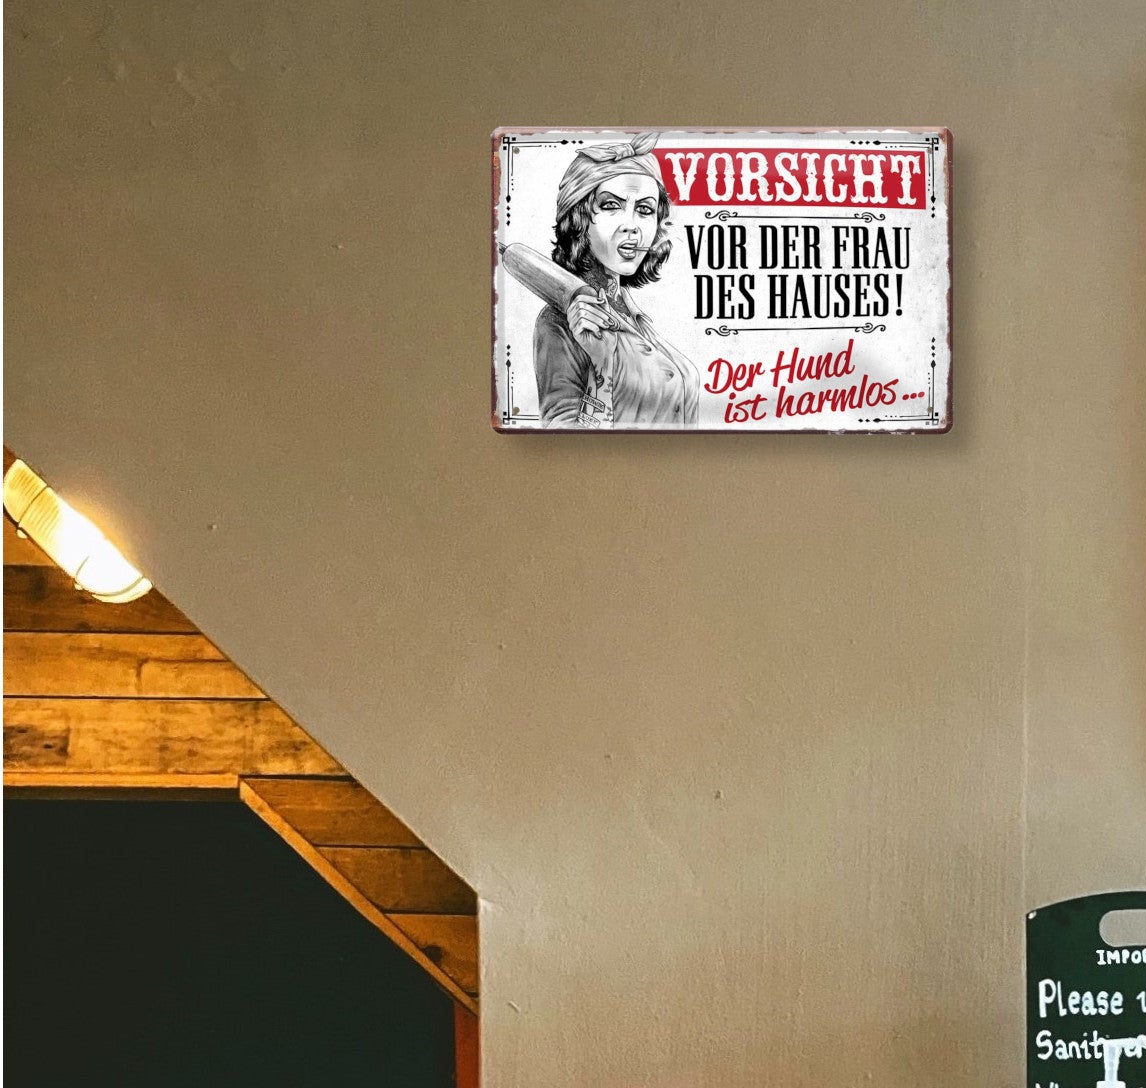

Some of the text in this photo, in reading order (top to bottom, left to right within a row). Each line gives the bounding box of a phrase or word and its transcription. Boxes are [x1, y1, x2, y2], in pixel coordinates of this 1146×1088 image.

[665, 150, 921, 206] VORSICHT
[684, 225, 912, 270] VOR DER FRAU
[693, 273, 904, 320] DES HAUSES!
[703, 339, 856, 393] Der Hund
[723, 391, 766, 424] ist
[1037, 978, 1124, 1018] Please
[1035, 1030, 1145, 1060] Saniter
